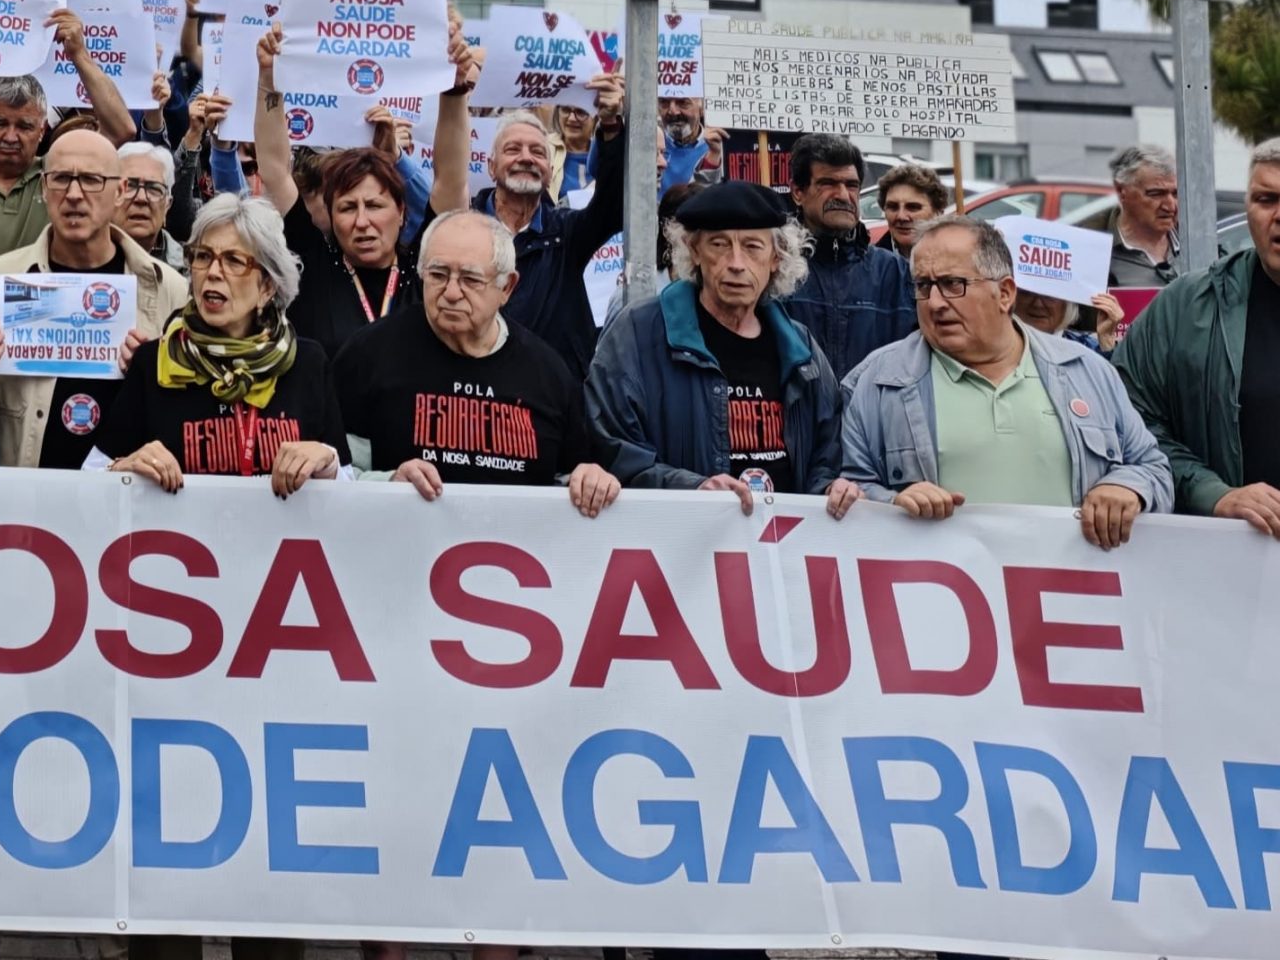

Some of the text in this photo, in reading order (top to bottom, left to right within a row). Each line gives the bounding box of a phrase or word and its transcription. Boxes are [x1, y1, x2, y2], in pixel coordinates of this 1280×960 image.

[317, 21, 415, 41] NON PODE
[317, 38, 411, 58] AGARDAR
[515, 36, 585, 56] COA NOSA
[680, 61, 698, 73] SE
[754, 48, 961, 70] MAIS MEDICOS NA PUBLICA
[515, 72, 575, 89] NON SE
[734, 61, 988, 84] MENOS MERCENARIOS NA PRIVADA
[727, 74, 996, 98] MAIS PRUEBAS E MENOS PASTILLAS
[719, 87, 762, 99] MENOS
[773, 90, 826, 102] LISTAS
[838, 93, 852, 104] DE
[864, 94, 917, 106] ESPERA
[705, 100, 741, 111] PARA
[811, 105, 854, 117] PASAR
[865, 109, 899, 119] POLO
[910, 110, 982, 124] HOSPITAL
[732, 114, 965, 138] PARALELO PRIVADO E PAGANDO
[7, 346, 117, 360] LISTAS DE AGARDA
[454, 382, 494, 398] POLA
[728, 386, 762, 397] POLA
[422, 449, 525, 472] DA NOSA SANIDADE
[428, 516, 1145, 713] SAÚDE
